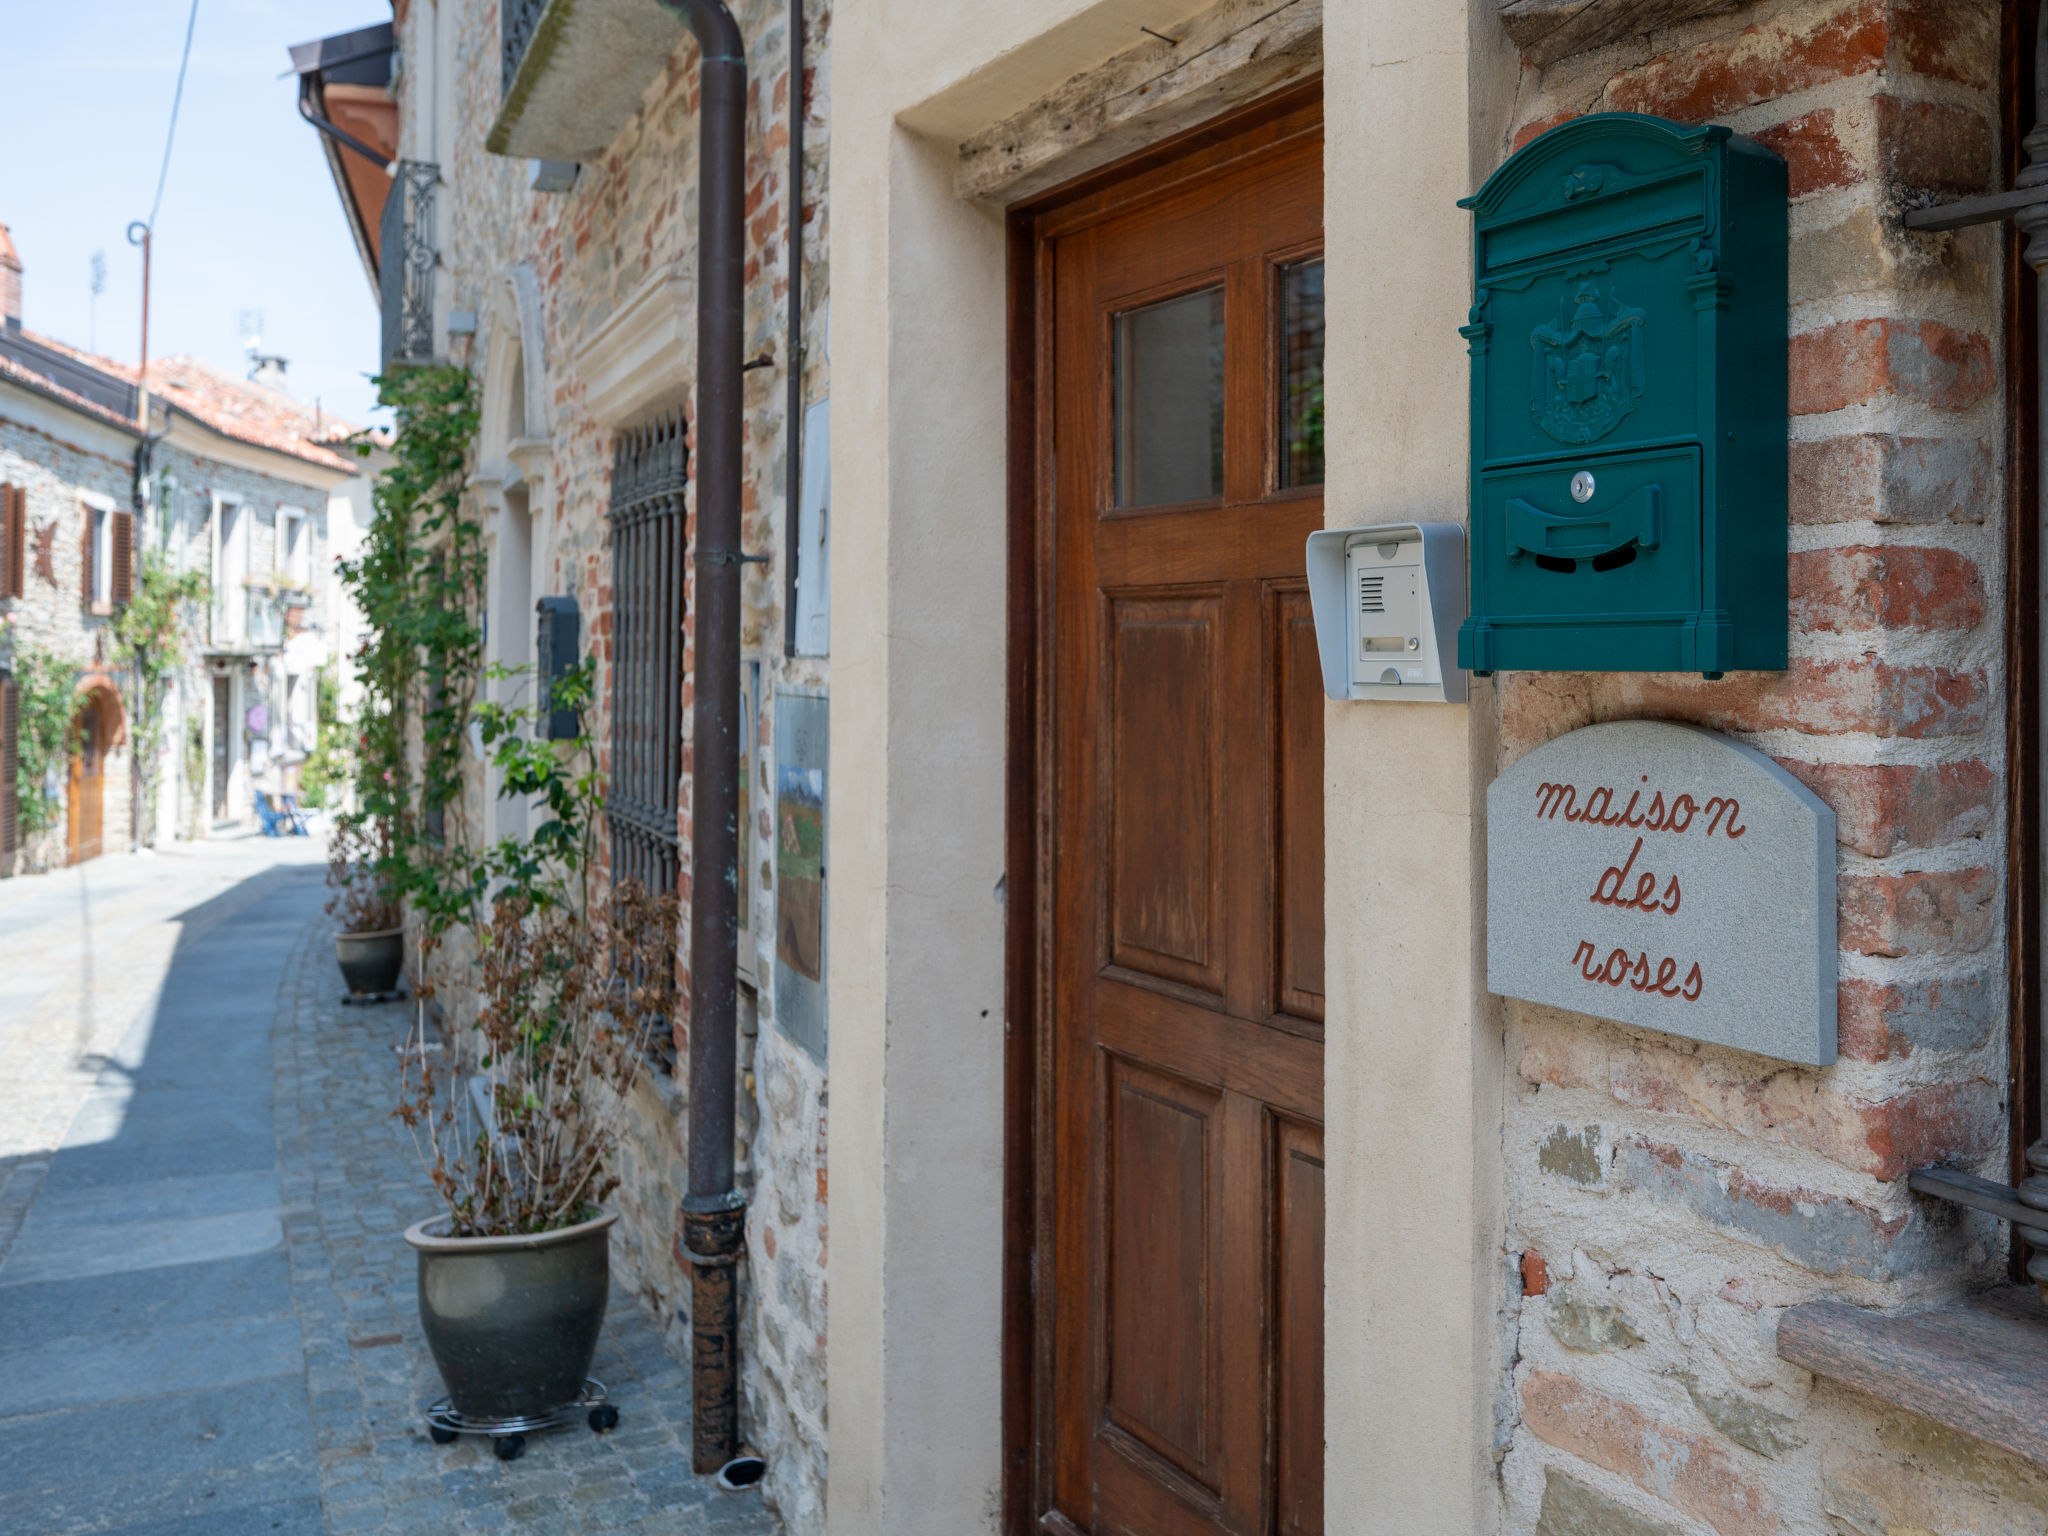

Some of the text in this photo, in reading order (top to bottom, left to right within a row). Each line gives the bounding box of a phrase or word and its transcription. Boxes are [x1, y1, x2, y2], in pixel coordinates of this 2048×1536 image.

[1535, 774, 1747, 839] maison
[1589, 836, 1682, 916] des
[1571, 940, 1704, 1002] roses
